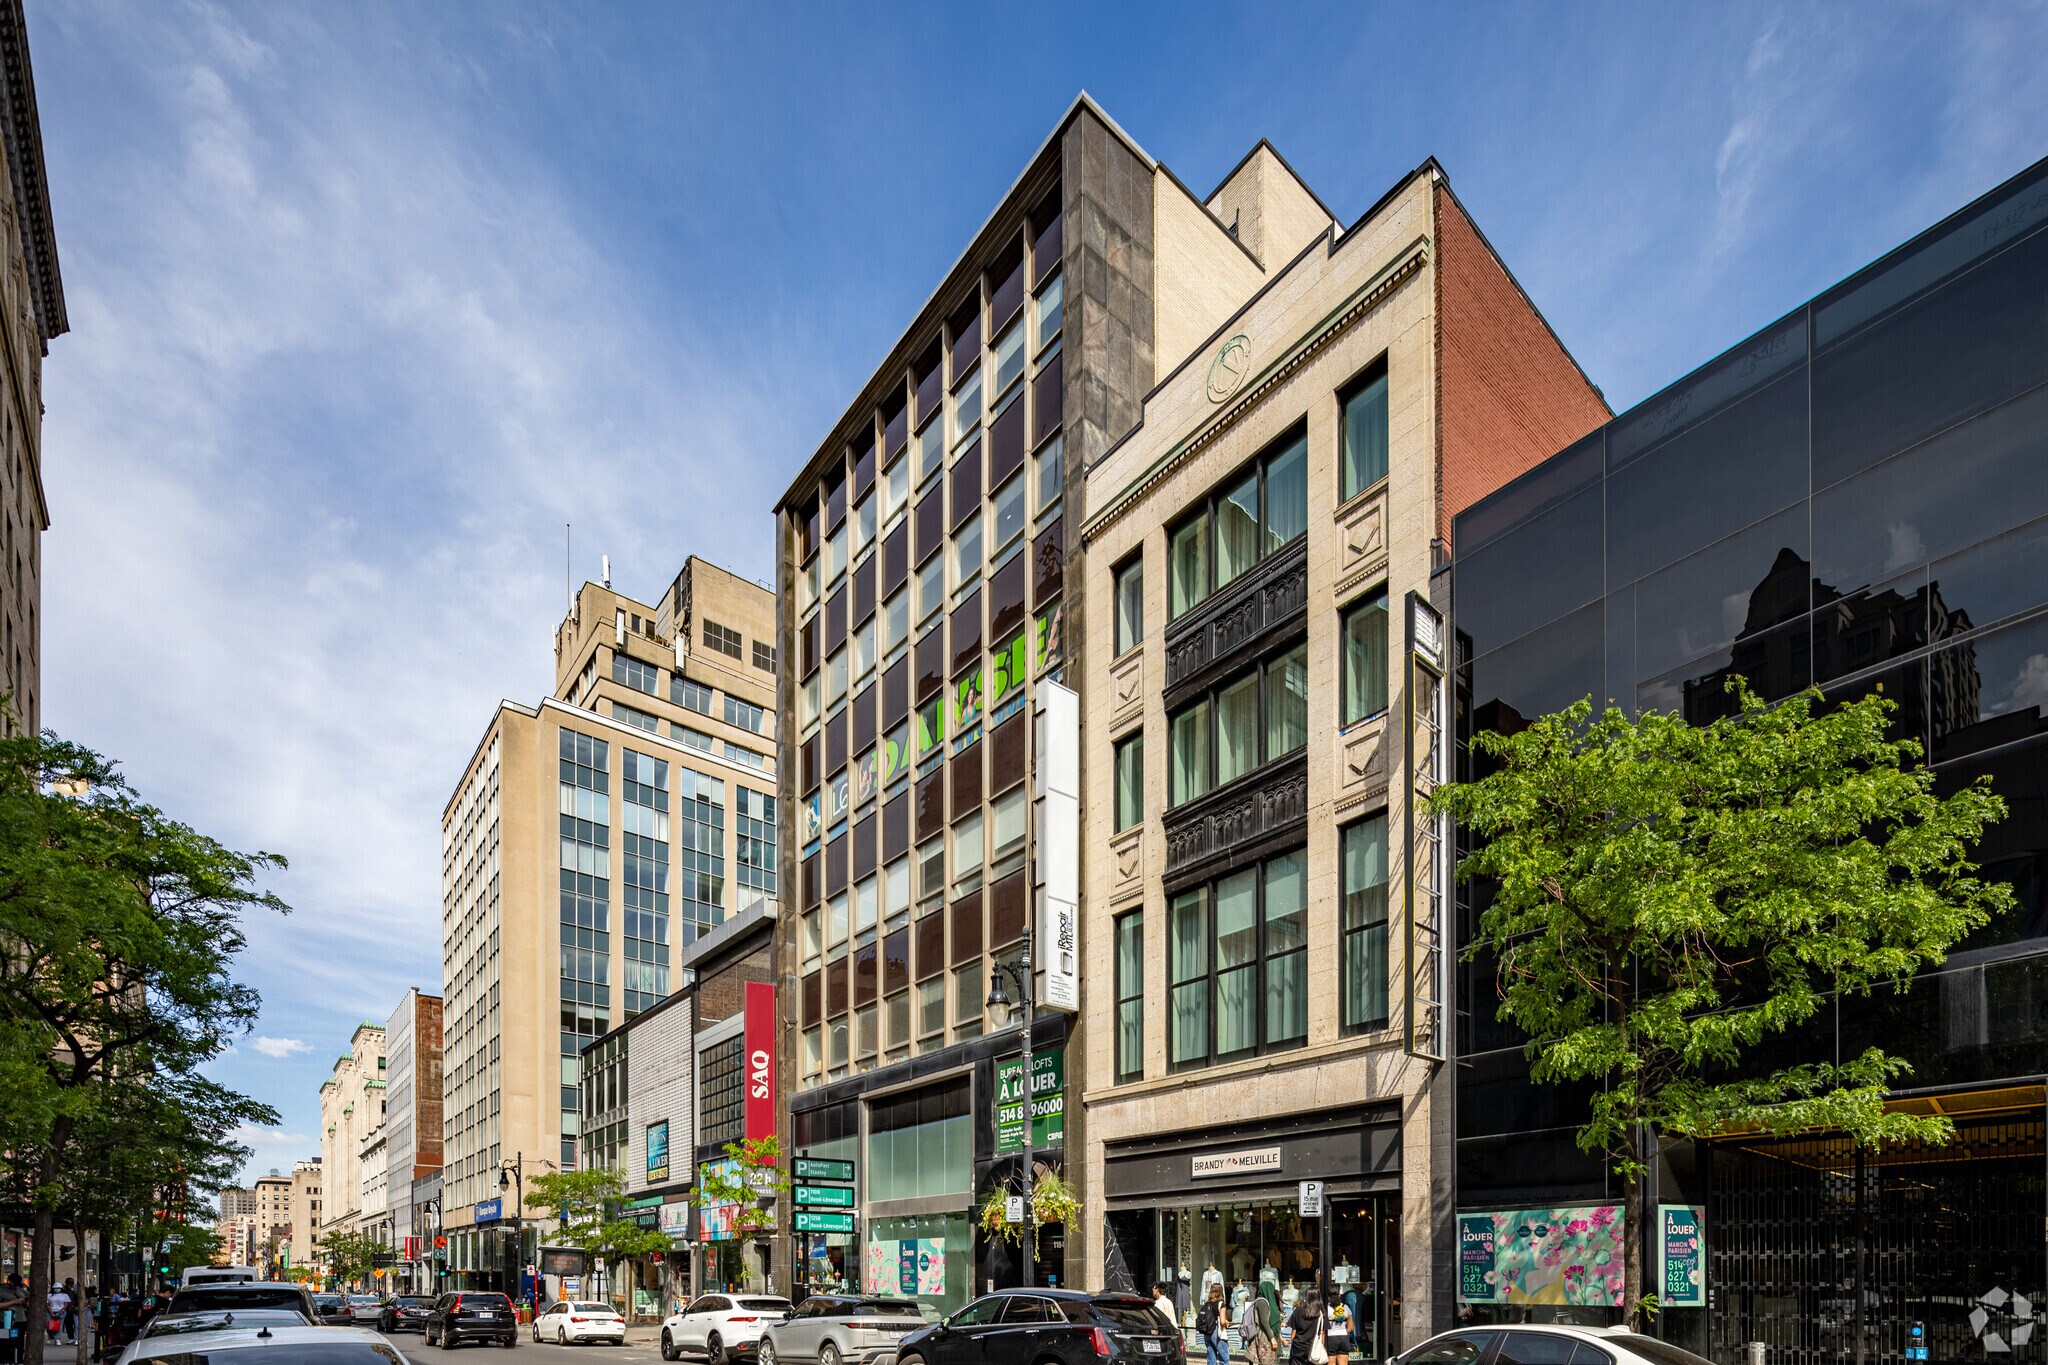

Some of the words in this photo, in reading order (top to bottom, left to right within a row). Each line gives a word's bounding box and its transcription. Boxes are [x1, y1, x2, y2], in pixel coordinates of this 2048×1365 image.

[751, 1050, 770, 1099] SAQ
[1000, 1079, 1010, 1100] À
[1000, 1108, 1016, 1123] 514
[1194, 1160, 1225, 1171] BRANDY
[1239, 1153, 1278, 1167] MELVILLE
[1307, 1183, 1316, 1196] P
[1011, 1197, 1018, 1207] P
[640, 1214, 656, 1226] AUDIO
[1667, 1212, 1674, 1225] À
[1463, 1222, 1469, 1233] À
[1667, 1225, 1694, 1235] LOUER
[1463, 1232, 1493, 1242] LOUER
[1463, 1265, 1480, 1274] 514
[1667, 1260, 1683, 1270] 514
[1463, 1274, 1481, 1283] 627
[1667, 1271, 1684, 1281] 627
[1463, 1283, 1487, 1292] 0321
[1667, 1282, 1689, 1292] 0321
